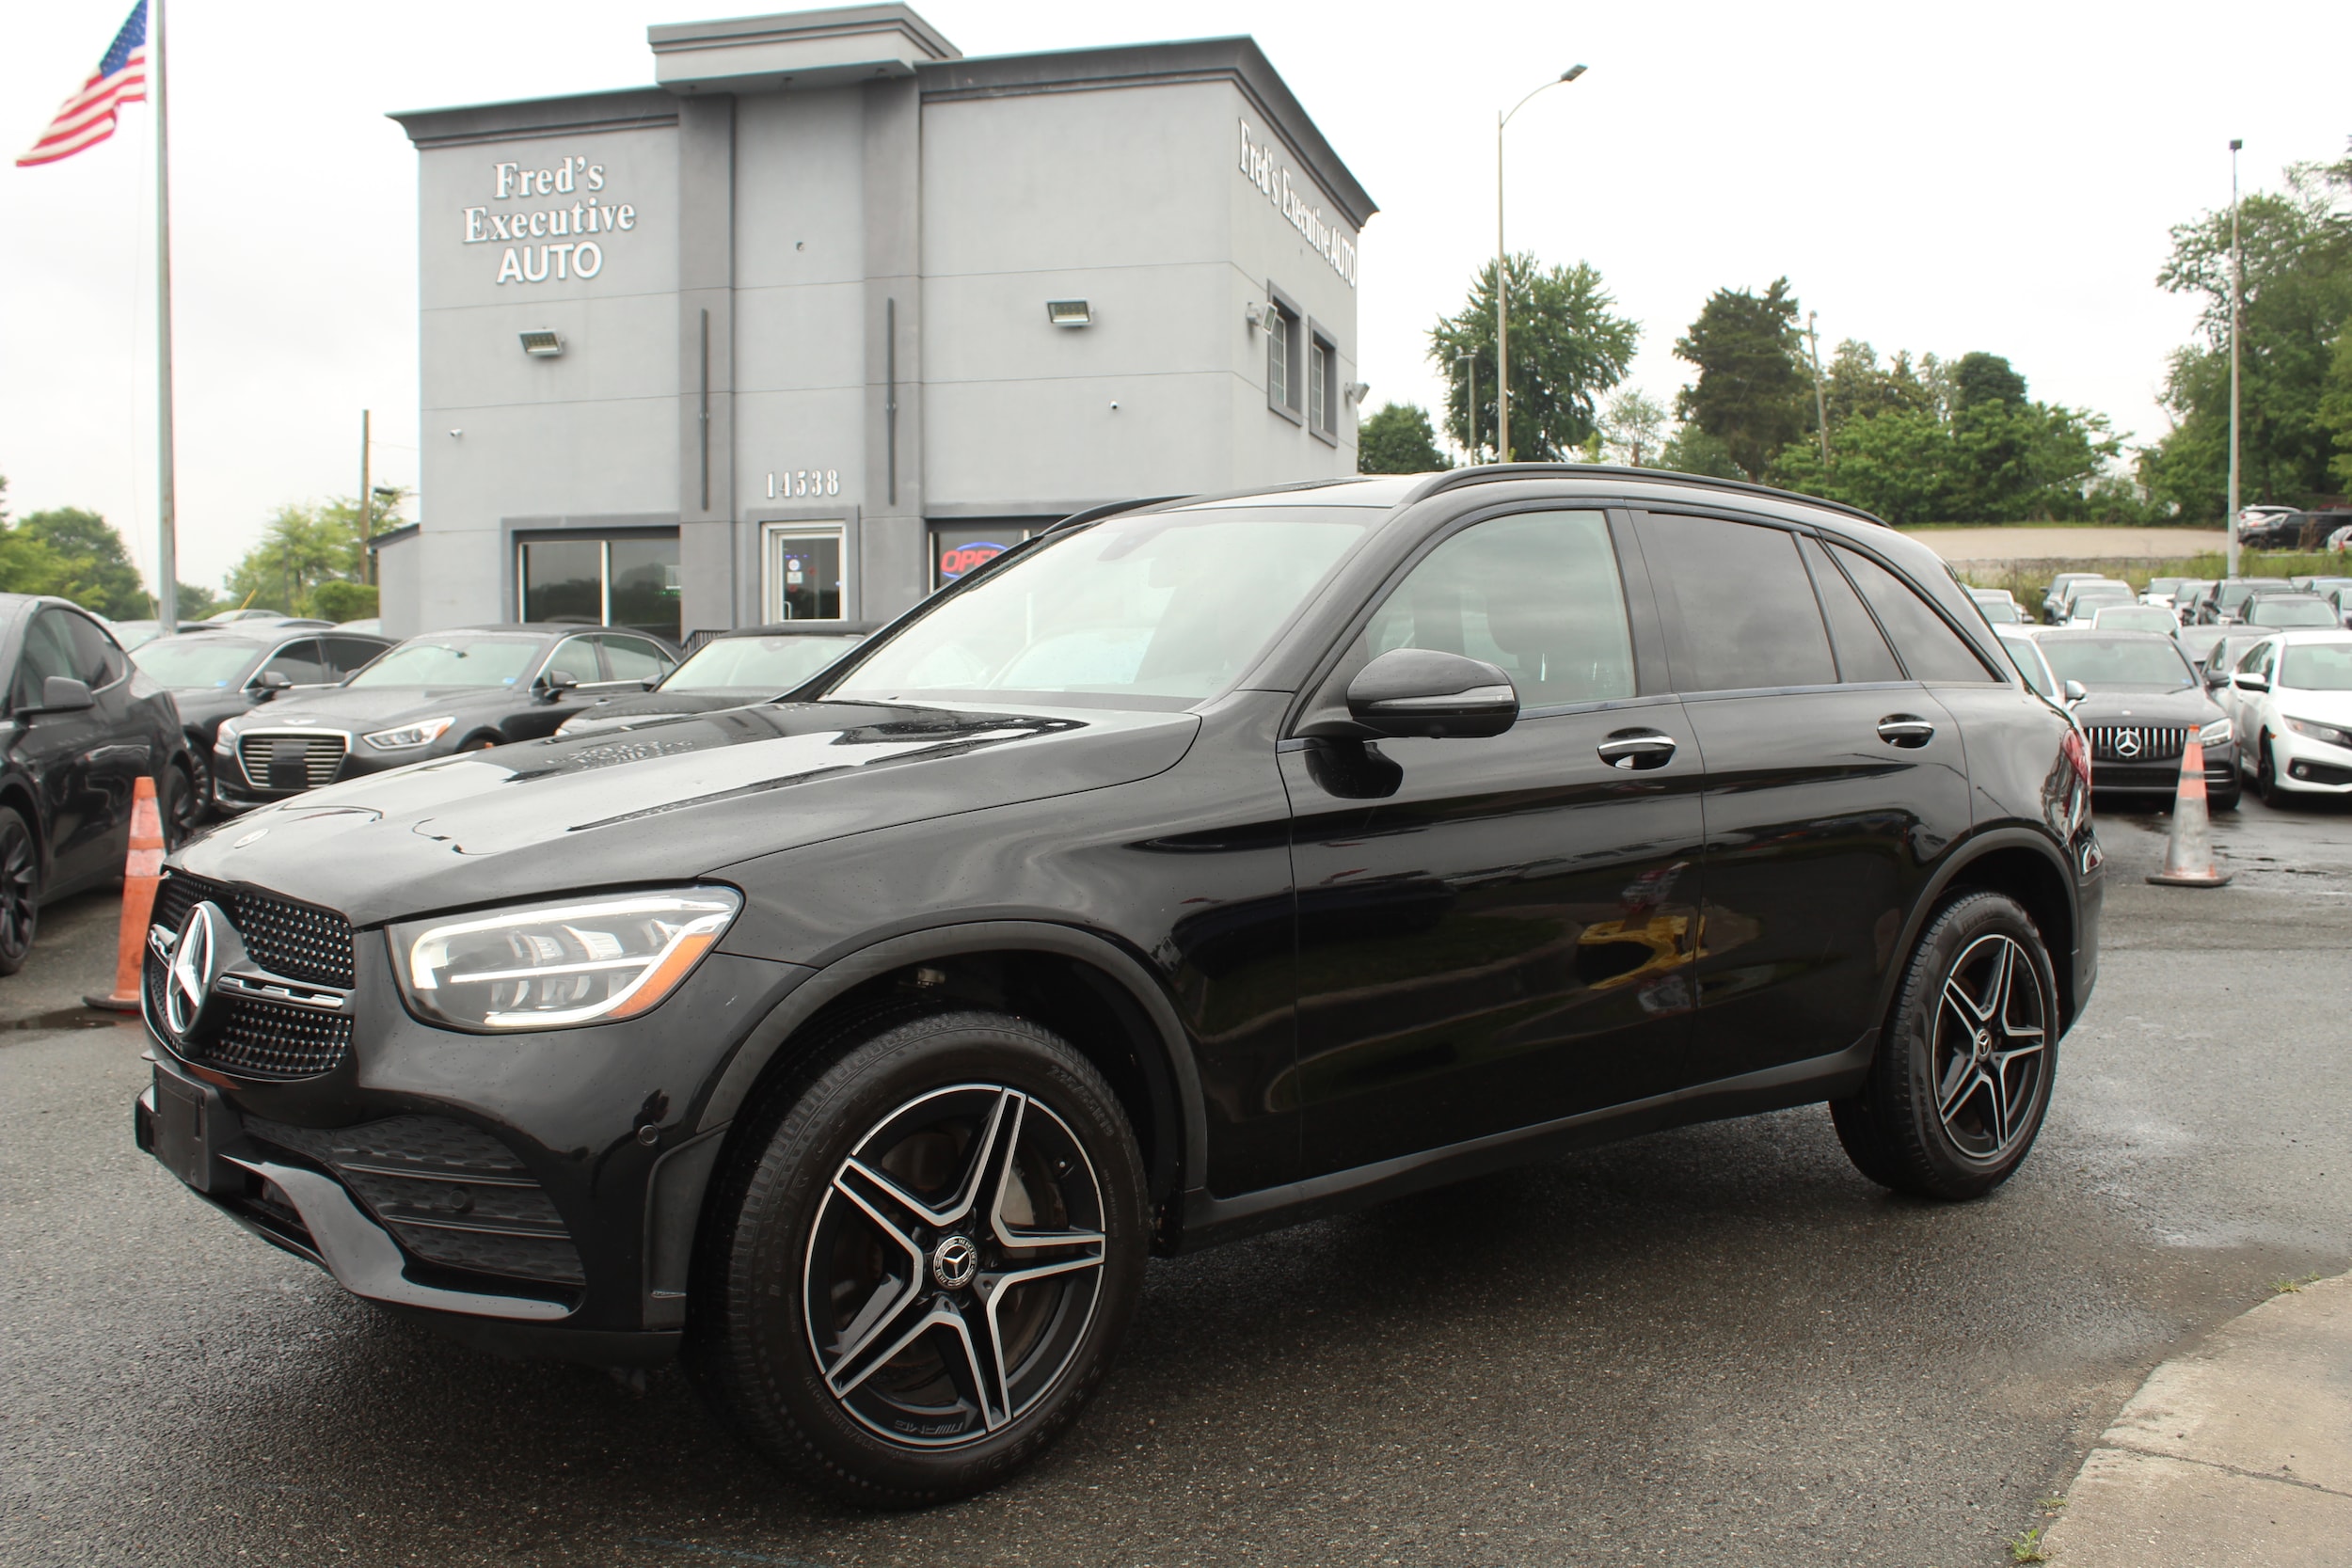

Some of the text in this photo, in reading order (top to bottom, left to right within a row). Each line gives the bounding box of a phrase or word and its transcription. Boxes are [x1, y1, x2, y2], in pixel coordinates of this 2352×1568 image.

[493, 155, 605, 199] Fred's
[462, 197, 636, 244] Executive
[1239, 117, 1357, 288] Fred's Executive AUTO
[496, 240, 603, 284] AUTO
[766, 468, 839, 499] 14538
[941, 550, 998, 573] OPE
